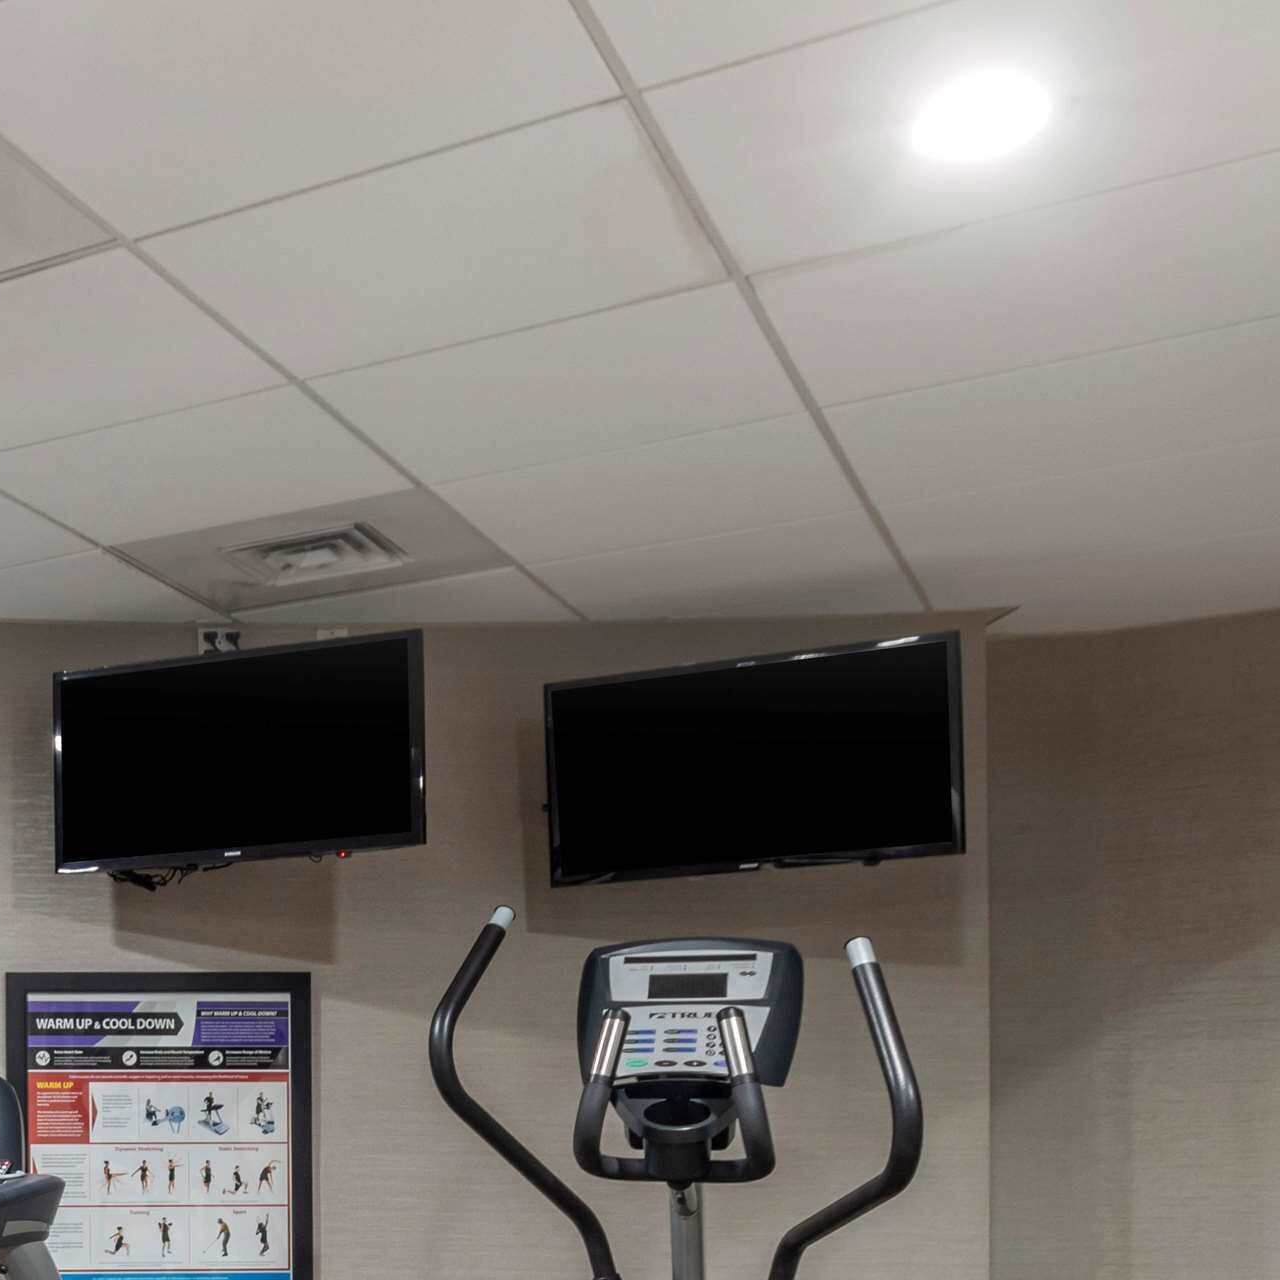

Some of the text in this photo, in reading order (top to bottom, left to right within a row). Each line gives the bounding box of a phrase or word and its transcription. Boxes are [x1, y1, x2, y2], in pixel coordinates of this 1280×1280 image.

[36, 1018, 175, 1030] WARM UP & COOL DOWN
